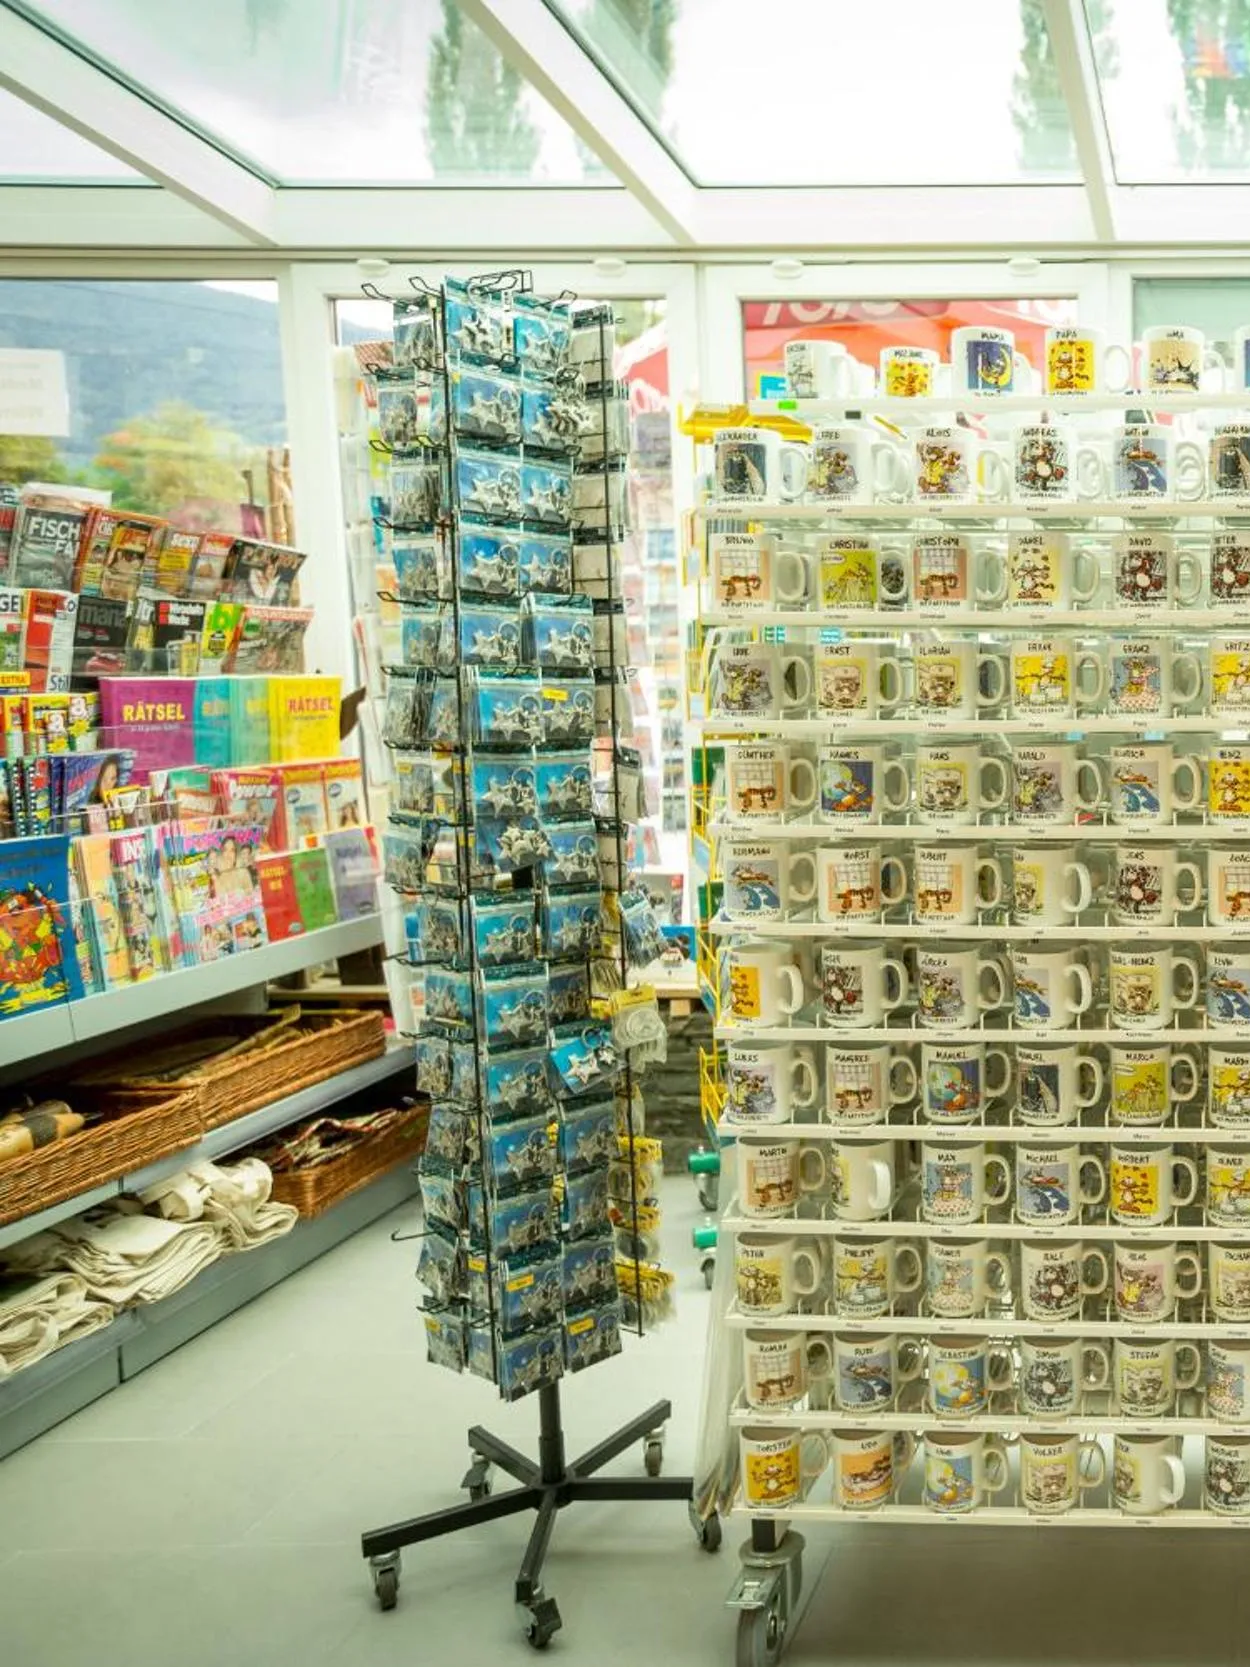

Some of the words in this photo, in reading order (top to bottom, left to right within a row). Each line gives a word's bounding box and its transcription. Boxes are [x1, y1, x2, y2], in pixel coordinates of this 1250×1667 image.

[28, 516, 80, 540] FISCH
[122, 700, 186, 722] RÄTSEL
[287, 697, 334, 713] RÄTSEL
